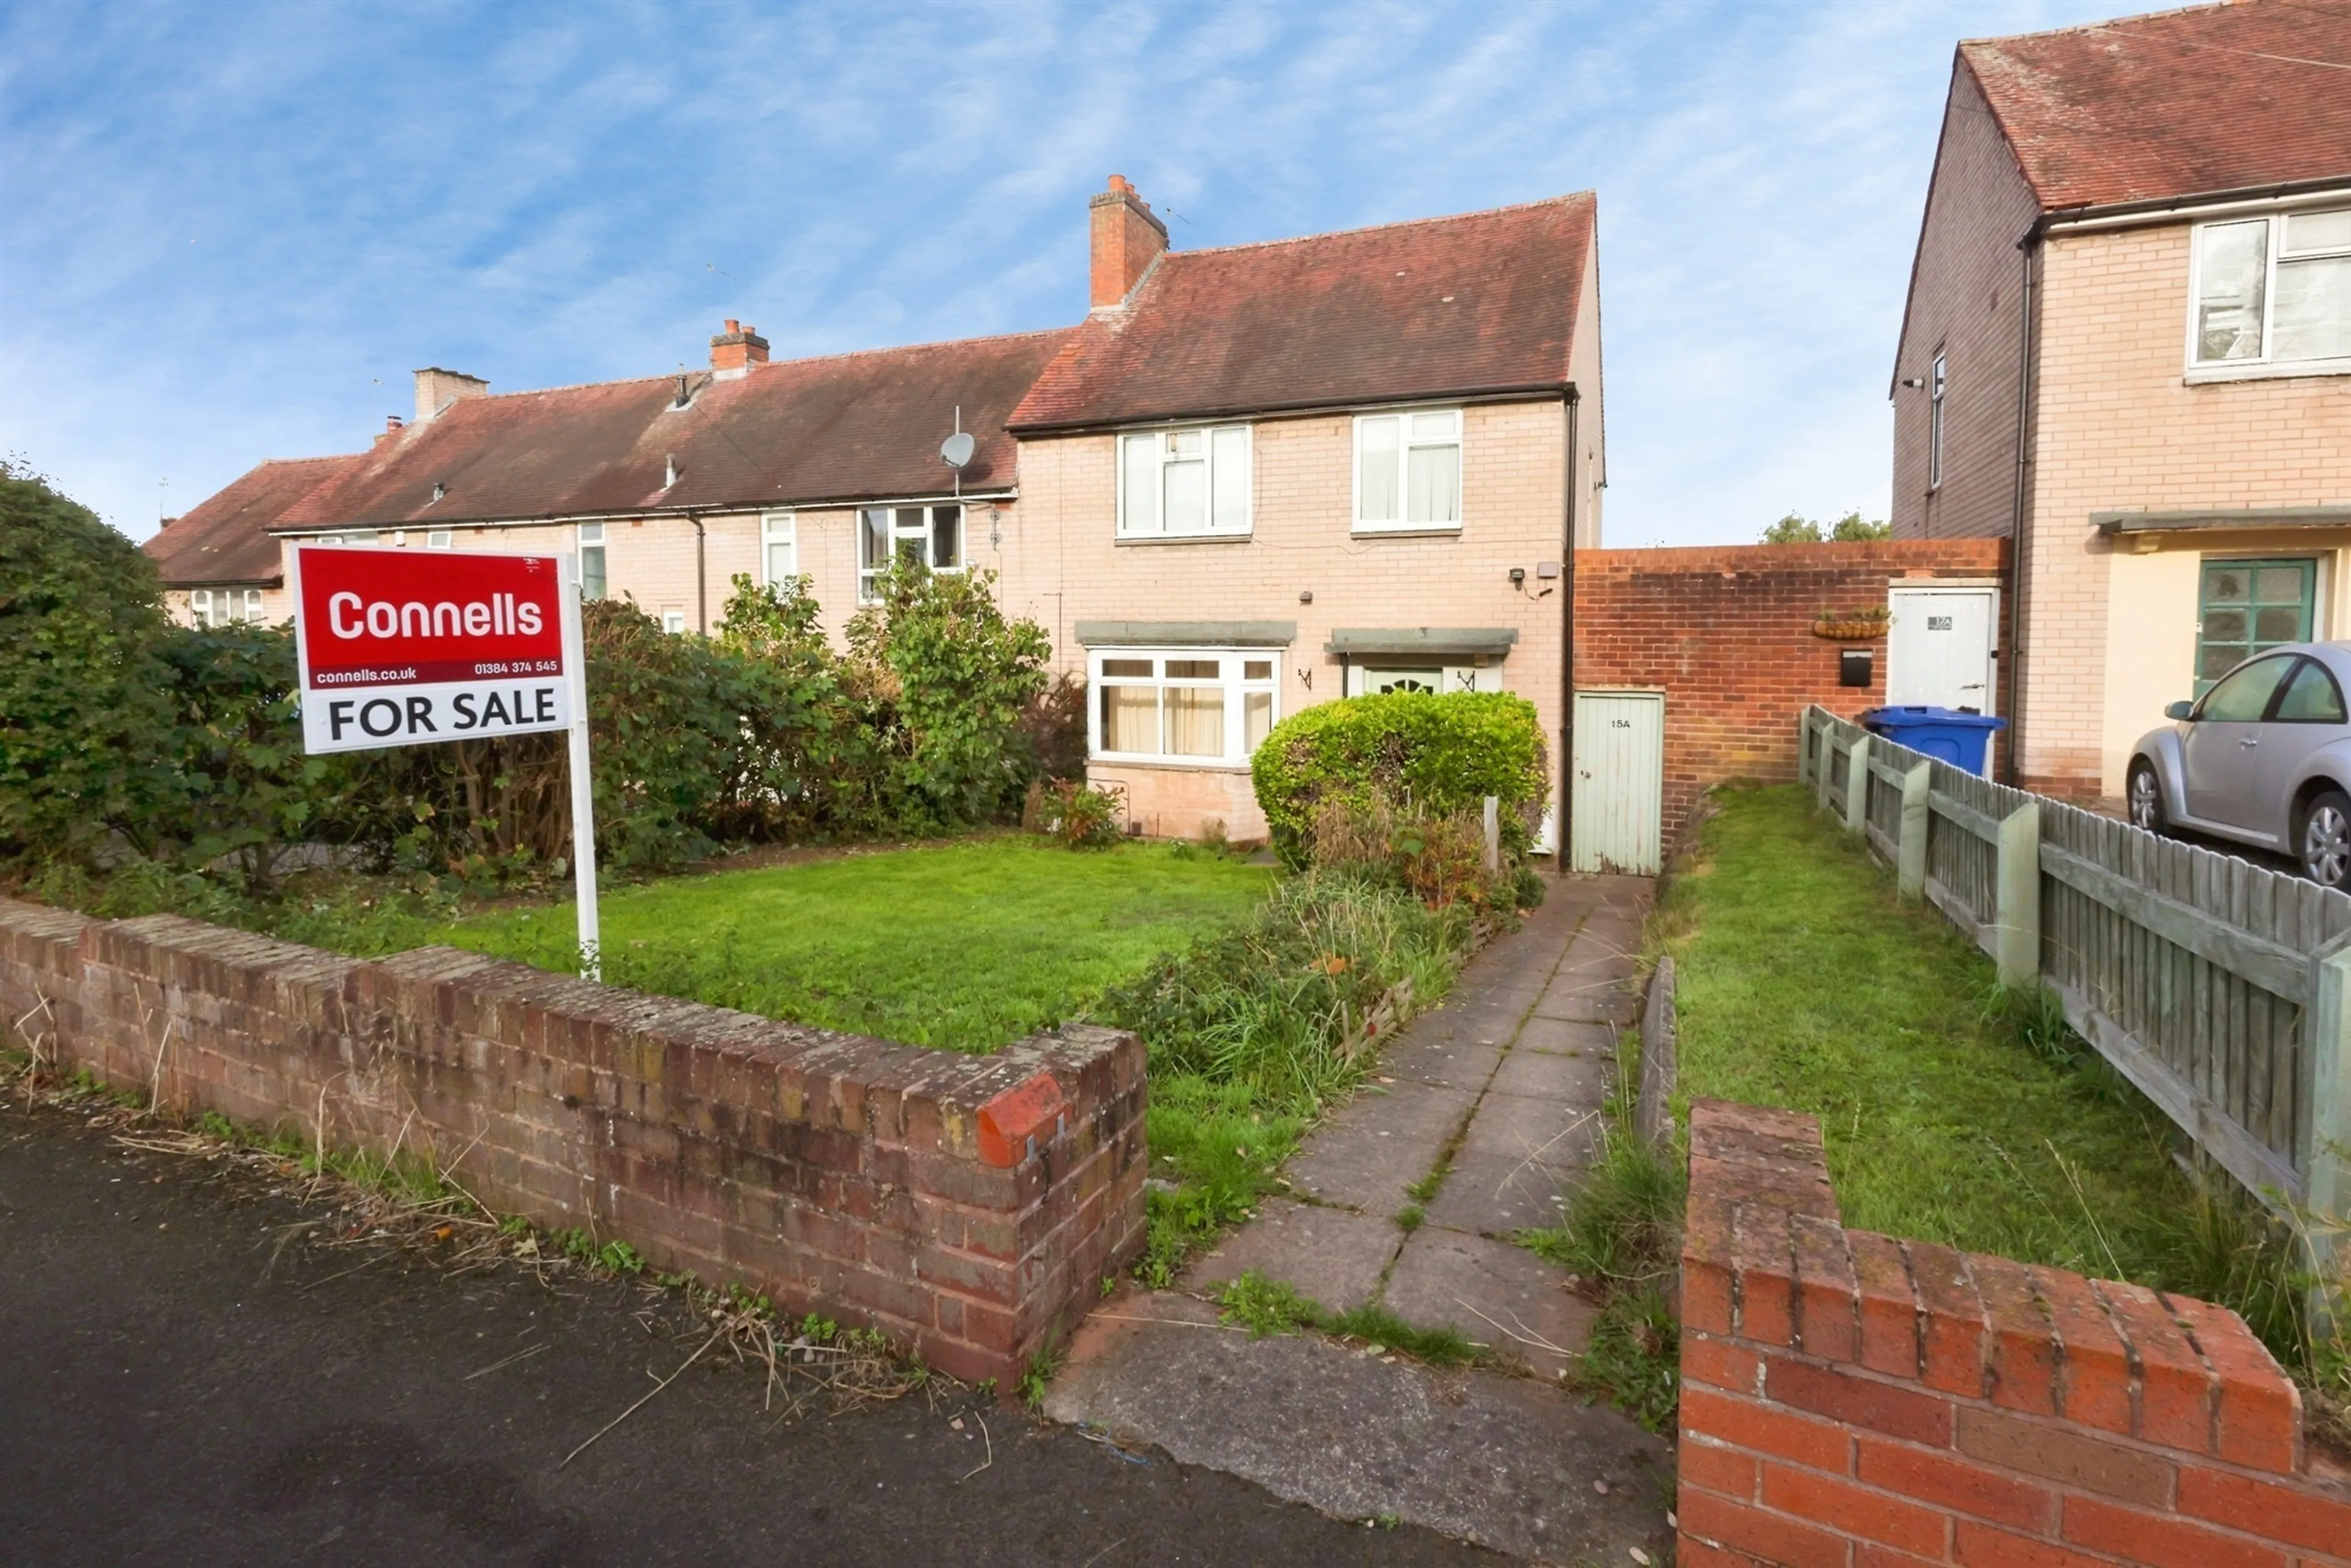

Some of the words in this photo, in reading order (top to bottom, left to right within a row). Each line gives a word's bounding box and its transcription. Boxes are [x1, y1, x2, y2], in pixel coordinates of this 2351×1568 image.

[329, 591, 543, 639] Connells
[317, 667, 417, 684] connells.co.uk
[474, 663, 508, 675] 01384
[512, 662, 531, 673] 374
[536, 661, 557, 672] 545
[329, 696, 438, 741] FOR
[452, 688, 556, 729] SALE
[1611, 719, 1631, 729] 15A
